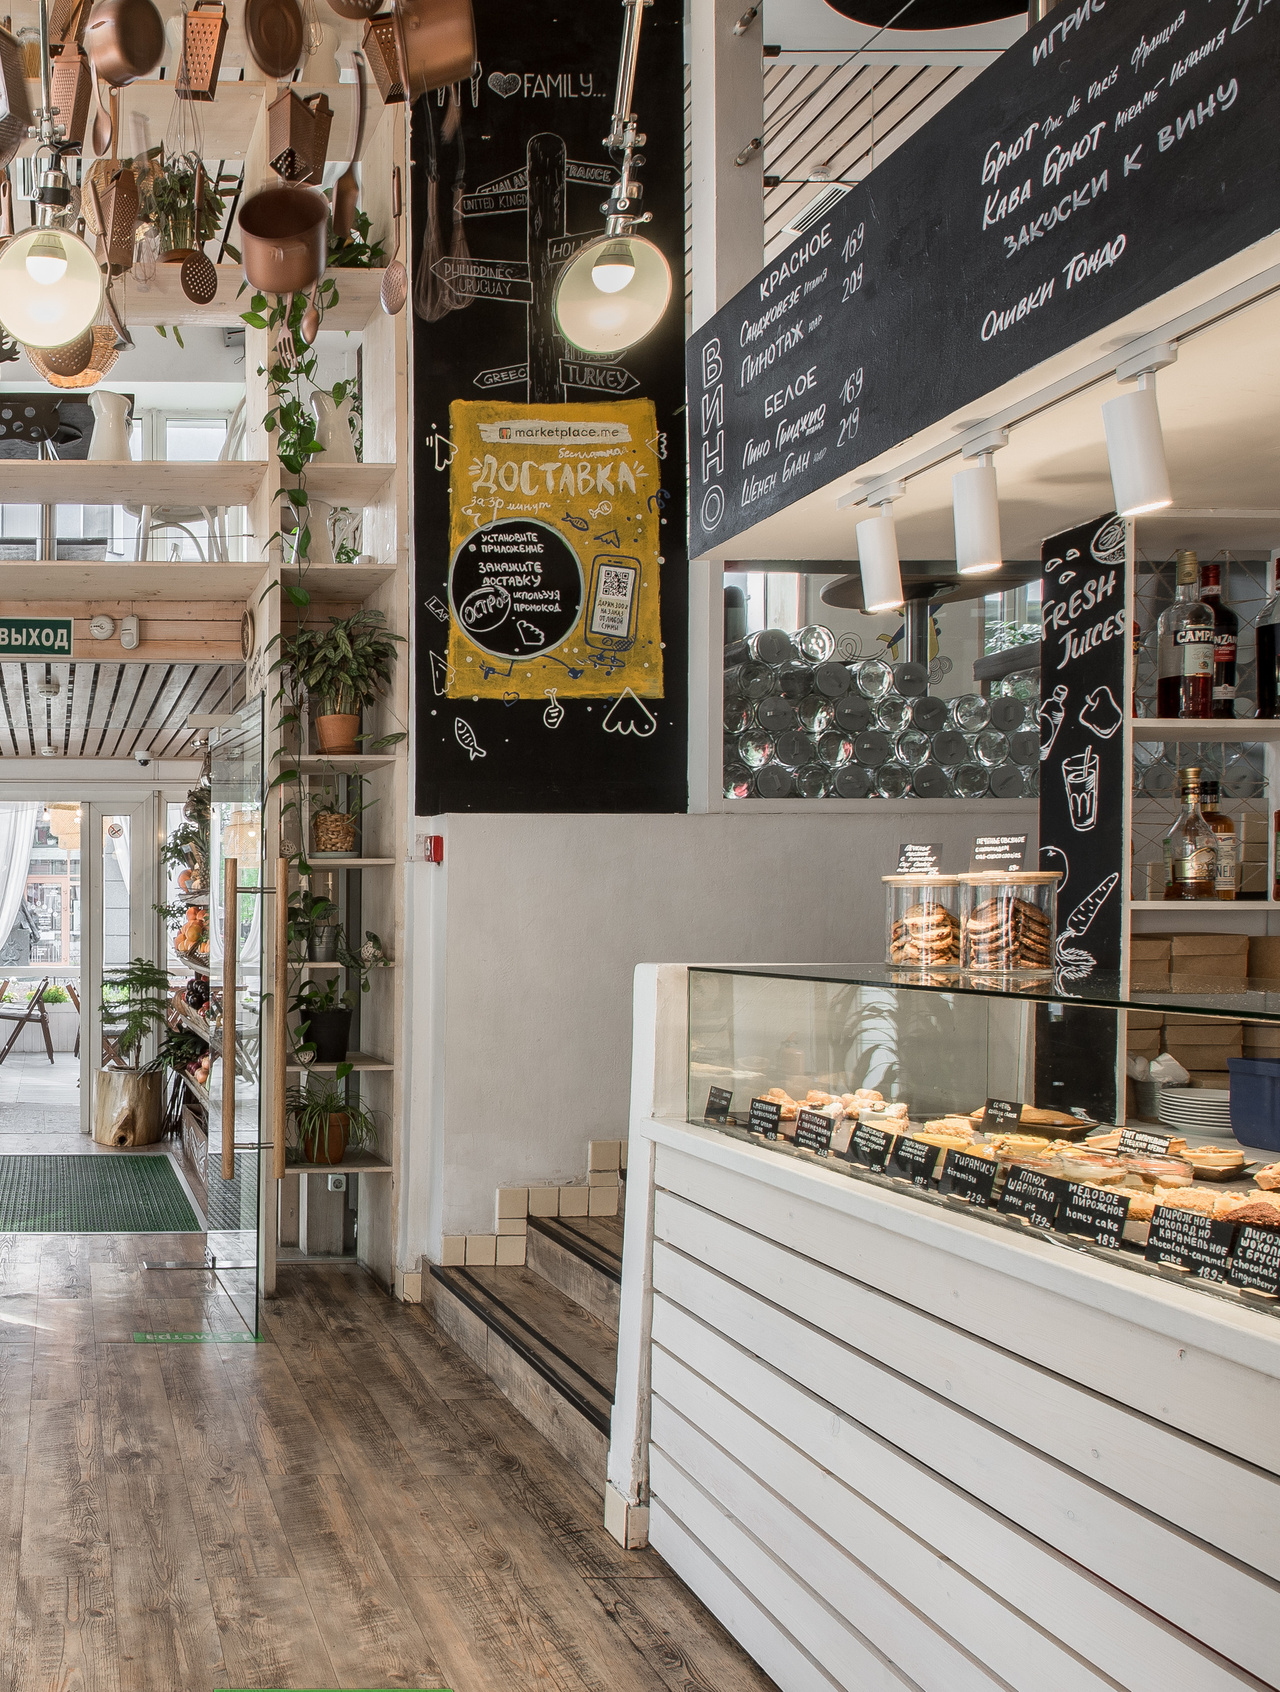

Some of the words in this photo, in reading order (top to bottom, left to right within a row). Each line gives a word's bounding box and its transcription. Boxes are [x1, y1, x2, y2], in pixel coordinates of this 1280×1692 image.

[1003, 169, 1109, 258] ЗАКУСКИ
[1123, 144, 1143, 177] К
[1157, 78, 1238, 152] ВИНУ
[463, 197, 495, 210] UNITED
[841, 222, 865, 263] 169
[759, 222, 833, 301] КРАСНОЕ
[841, 262, 864, 303] 209
[564, 364, 628, 389] TURKEY
[838, 367, 863, 406] 169
[764, 365, 817, 419] БЕЛОЕ
[515, 426, 620, 439] marketplace.me
[701, 337, 725, 532] ВИНО
[836, 407, 860, 448] 219
[472, 454, 637, 497] ДОСТАВКА
[506, 501, 551, 516] минут
[481, 532, 539, 542] УСТАНОВИТЕ
[481, 544, 545, 554] ПРИЛОЖЕНИЕ
[478, 561, 543, 573] ЗАКАЖИТЕ
[481, 574, 541, 587] ДОСТАВКУ
[513, 590, 561, 600] ИСПОЛЬЗУЯ
[1041, 570, 1116, 641] FRESH
[513, 603, 562, 612] ПРОМОКОД
[947, 1166, 977, 1184] tiramisu
[954, 1153, 996, 1177] ТИРАМИСУ
[1068, 1183, 1120, 1205] МЕДОВОЕ
[1024, 1202, 1036, 1211] pie
[1072, 1195, 1124, 1218] ПИРОЖНОЕ
[1158, 1206, 1212, 1229] ПИРОЖНОЕ
[1065, 1206, 1092, 1224] honey
[1095, 1218, 1119, 1232] cake
[1148, 1236, 1226, 1268] chocolate-caramel
[1158, 1227, 1228, 1256] КАРАМЕЛЬНОЕ
[1160, 1252, 1182, 1265] cake
[1232, 1258, 1278, 1279] chocolate
[1230, 1268, 1278, 1293] lingonberry
